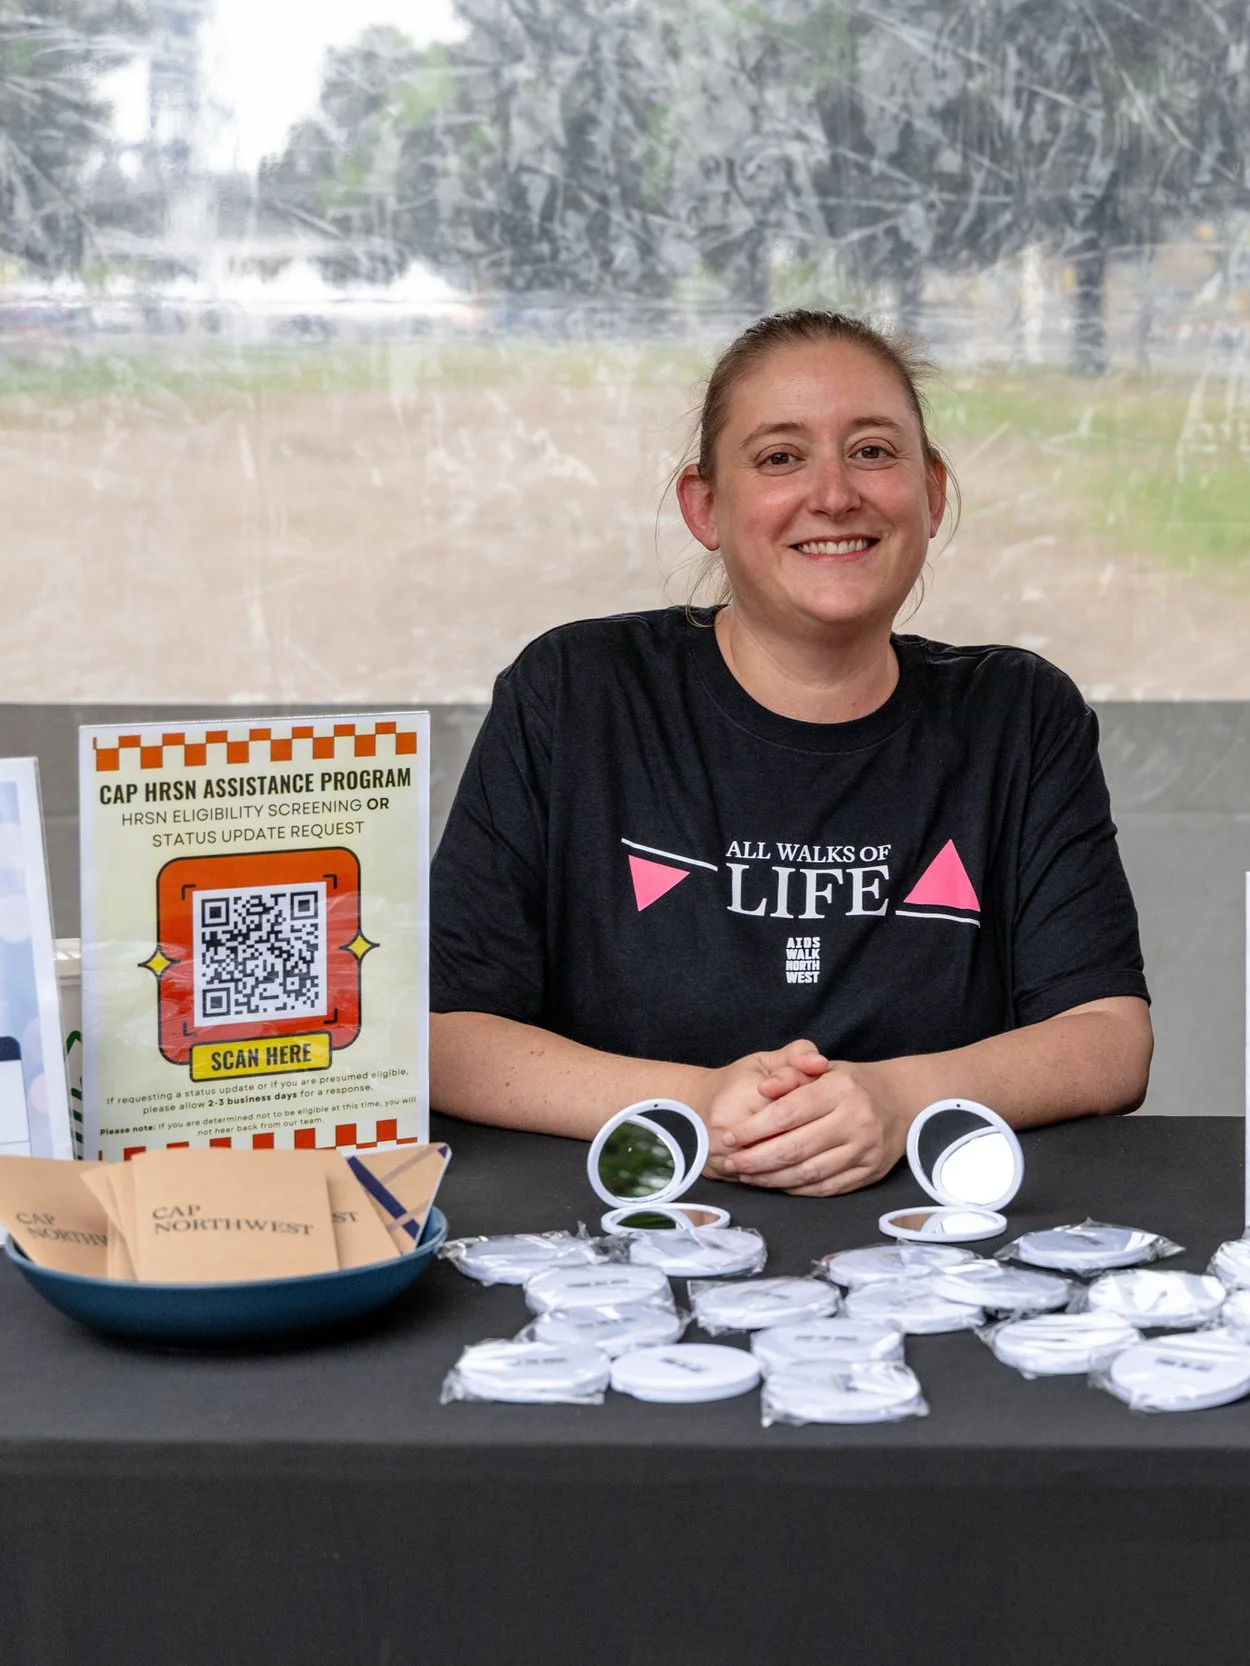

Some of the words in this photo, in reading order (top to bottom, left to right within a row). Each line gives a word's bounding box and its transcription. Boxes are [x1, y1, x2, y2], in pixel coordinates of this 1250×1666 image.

[100, 783, 138, 805] CAP
[145, 780, 196, 802] HRSN
[203, 773, 314, 799] ASSISTANCE
[321, 767, 411, 792] PROGRAM
[122, 811, 167, 826] HRSN
[173, 804, 263, 823] ELIGIBILITY
[268, 799, 362, 817] SCREENING
[366, 797, 389, 810] OR
[152, 831, 217, 848] STATUS
[221, 826, 285, 843] UPDATE
[291, 821, 364, 839] REQUEST
[725, 840, 771, 859] ALL
[776, 842, 856, 863] WALKS
[859, 844, 892, 862] OF
[725, 863, 889, 919] LIFE
[786, 936, 821, 948] AIDS
[785, 960, 820, 971] NORTH
[786, 948, 820, 960] WALK
[785, 971, 820, 983] WEST
[211, 1048, 259, 1071] SCAN
[265, 1043, 312, 1066] HERE
[106, 1096, 114, 1105] If
[117, 1092, 173, 1105] requesting
[185, 1088, 216, 1098] status
[219, 1083, 255, 1095] update
[257, 1082, 268, 1090] or
[270, 1080, 278, 1089] if
[280, 1080, 298, 1090] you
[301, 1078, 317, 1086] are
[319, 1072, 368, 1085] presumed
[371, 1067, 409, 1080] eligible,
[143, 1104, 176, 1115] please
[179, 1100, 205, 1111] allow
[208, 1098, 225, 1107] 2-3
[227, 1093, 271, 1106] business
[274, 1091, 298, 1102] days
[300, 1089, 314, 1098] for
[326, 1084, 374, 1096] response.
[100, 1124, 130, 1136] Please
[132, 1123, 156, 1134] note:
[167, 1121, 184, 1131] you
[186, 1119, 200, 1127] are
[202, 1114, 254, 1126] determined
[256, 1110, 270, 1120] not
[273, 1110, 283, 1118] to
[284, 1109, 295, 1117] be
[297, 1105, 329, 1117] eligible
[331, 1103, 340, 1112] at
[342, 1101, 359, 1111] this
[384, 1098, 400, 1108] you
[402, 1096, 417, 1105] will
[197, 1127, 213, 1137] not
[214, 1125, 234, 1136] hear
[236, 1123, 258, 1133] back
[260, 1120, 281, 1130] from
[283, 1119, 298, 1127] our
[16, 1212, 55, 1225] CAP
[153, 1204, 201, 1219] CAP
[154, 1218, 315, 1236] NORTHWEST
